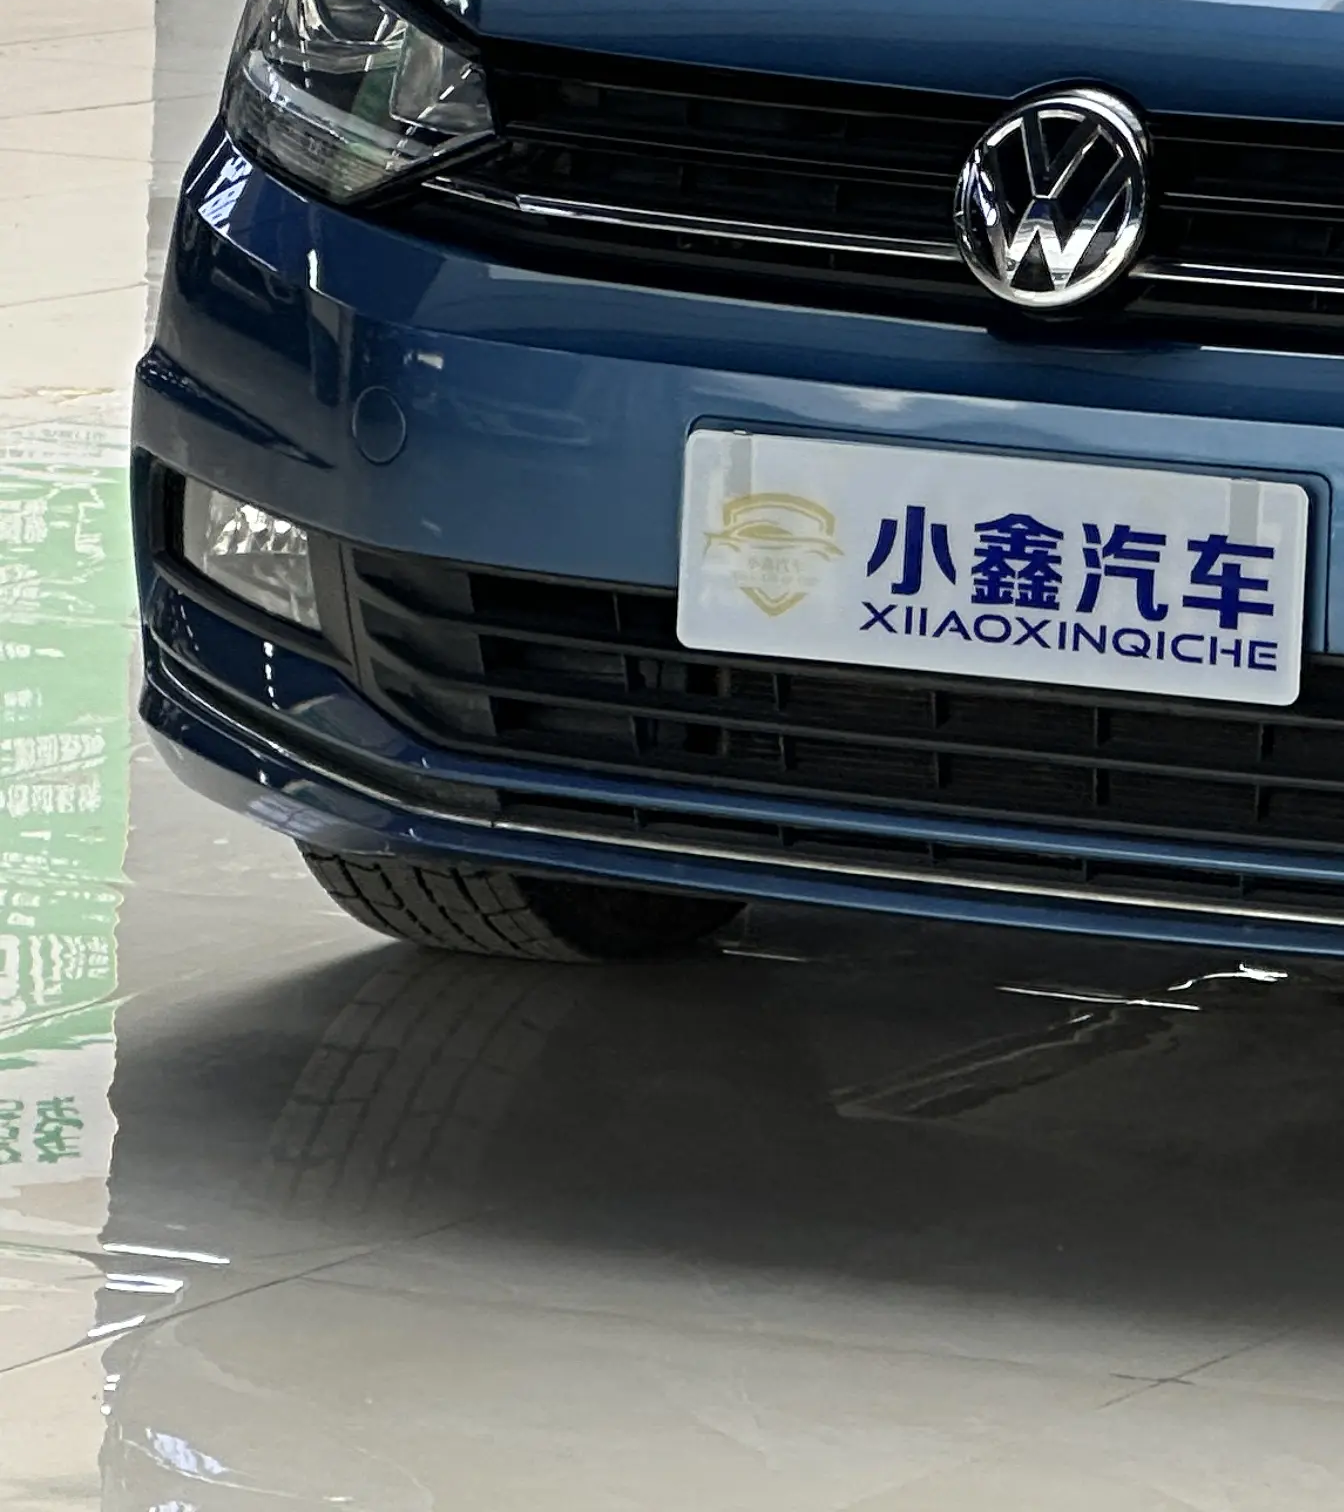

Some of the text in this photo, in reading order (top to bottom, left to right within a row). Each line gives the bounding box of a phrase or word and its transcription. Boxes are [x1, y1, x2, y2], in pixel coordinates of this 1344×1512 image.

[866, 504, 1277, 630] 小鑫汽车
[858, 601, 1279, 671] XIIAOXINQICHE
